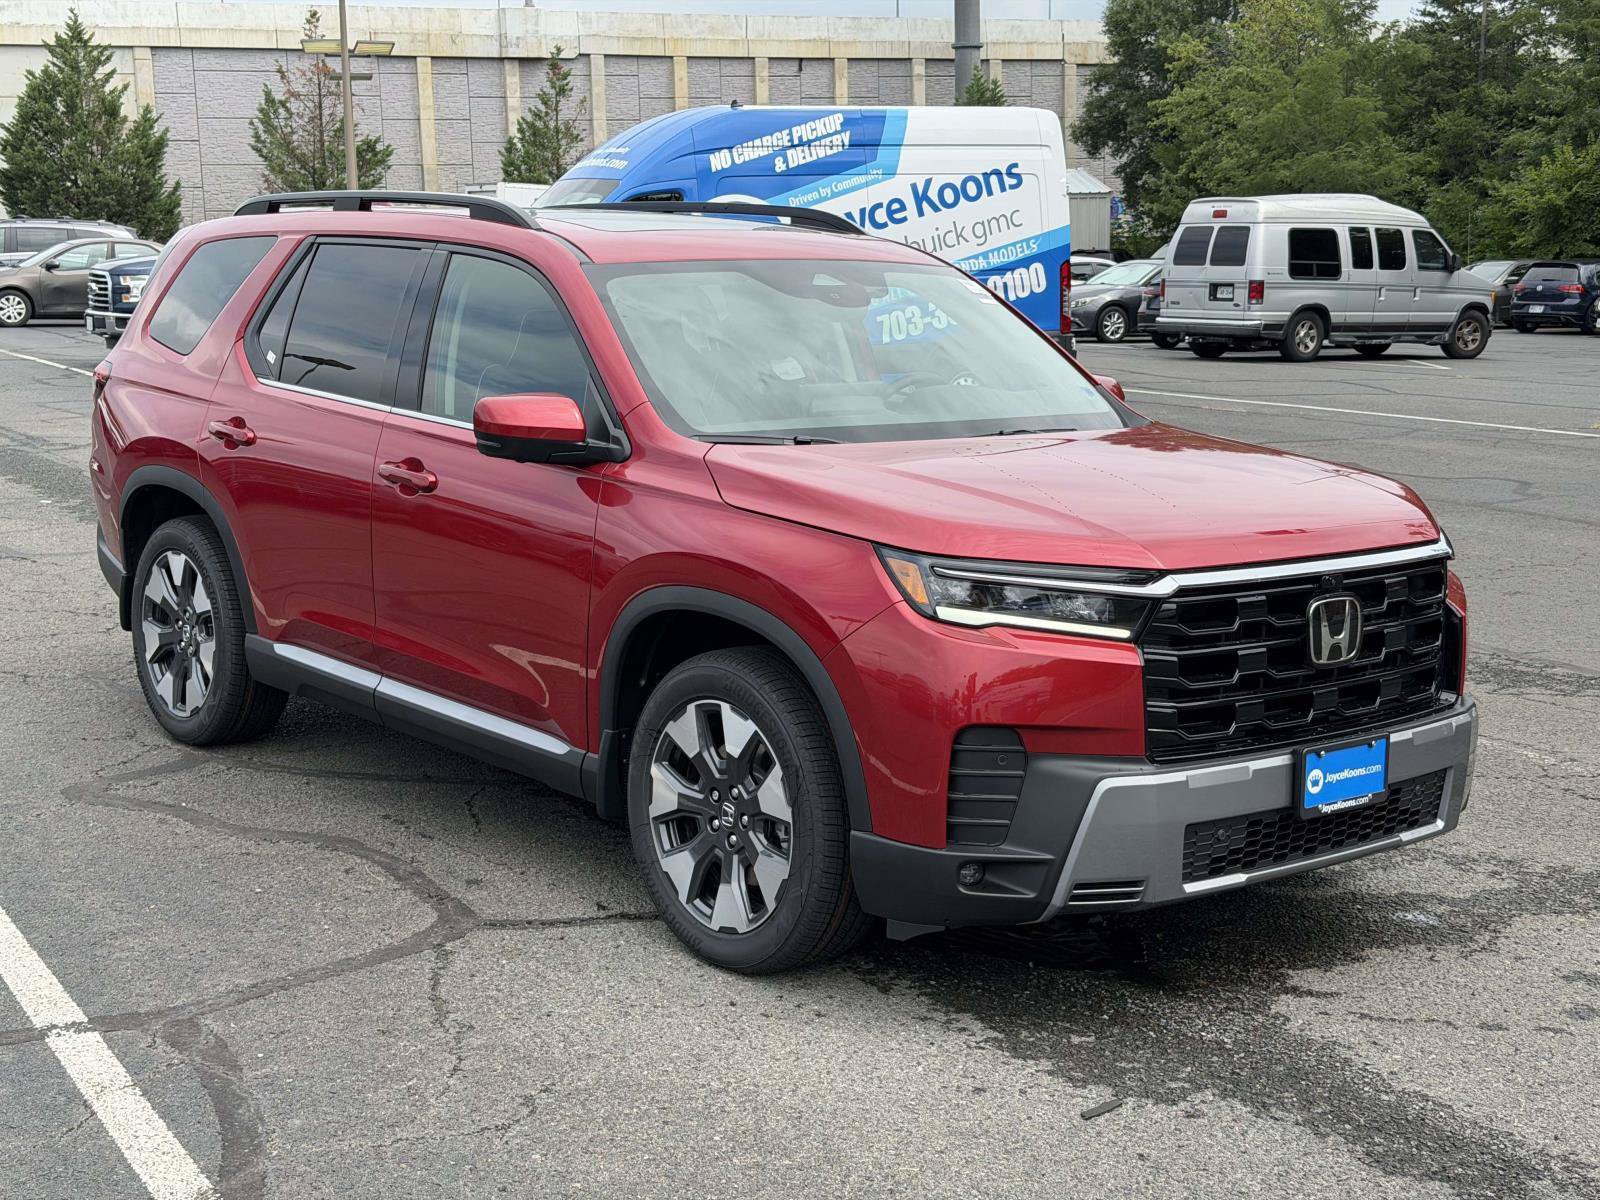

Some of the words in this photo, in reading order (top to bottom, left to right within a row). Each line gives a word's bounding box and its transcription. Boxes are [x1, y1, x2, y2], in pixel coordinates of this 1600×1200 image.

[709, 151, 732, 172] NO
[733, 129, 791, 165] CHARGE
[792, 112, 844, 145] PICKUP
[774, 156, 787, 173] &
[787, 131, 850, 169] DELIVERY
[788, 191, 819, 207] Driven
[820, 186, 832, 198] by
[831, 168, 883, 192] Community
[910, 162, 1023, 218] Koons
[972, 209, 1023, 247] gmc
[988, 238, 1038, 266] MODELS
[1325, 764, 1381, 783] JoyceKoons.com
[1321, 796, 1369, 813] JoyceKoons.com
